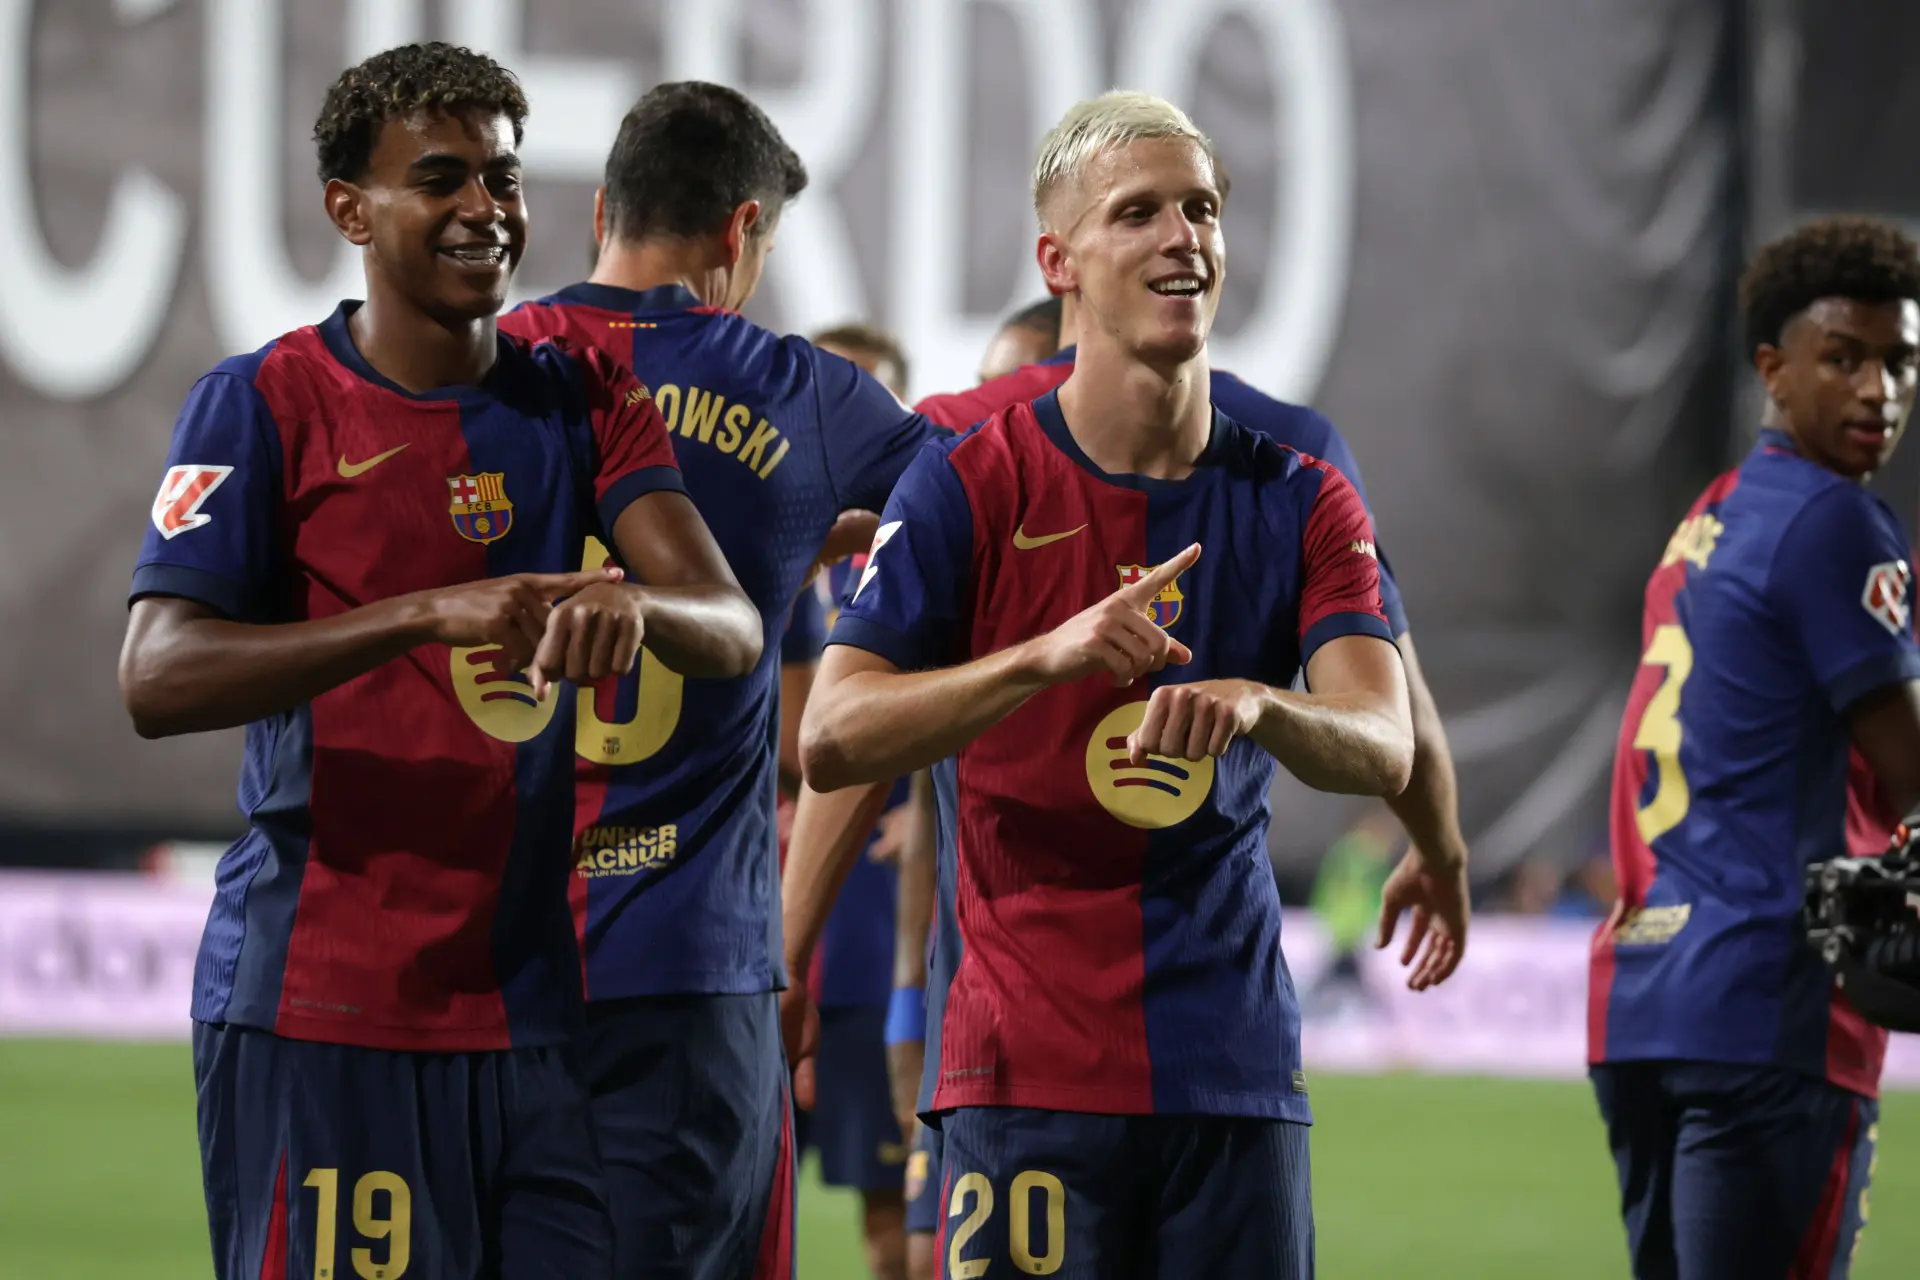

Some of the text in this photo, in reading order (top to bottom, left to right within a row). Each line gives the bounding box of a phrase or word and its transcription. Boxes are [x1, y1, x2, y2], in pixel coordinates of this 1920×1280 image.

[467, 502, 492, 512] FCB
[1633, 624, 1694, 845] 3
[576, 840, 677, 870] ACNUR
[583, 824, 677, 847] UNHCR
[302, 1167, 411, 1280] 19
[948, 1169, 1065, 1280] 20
